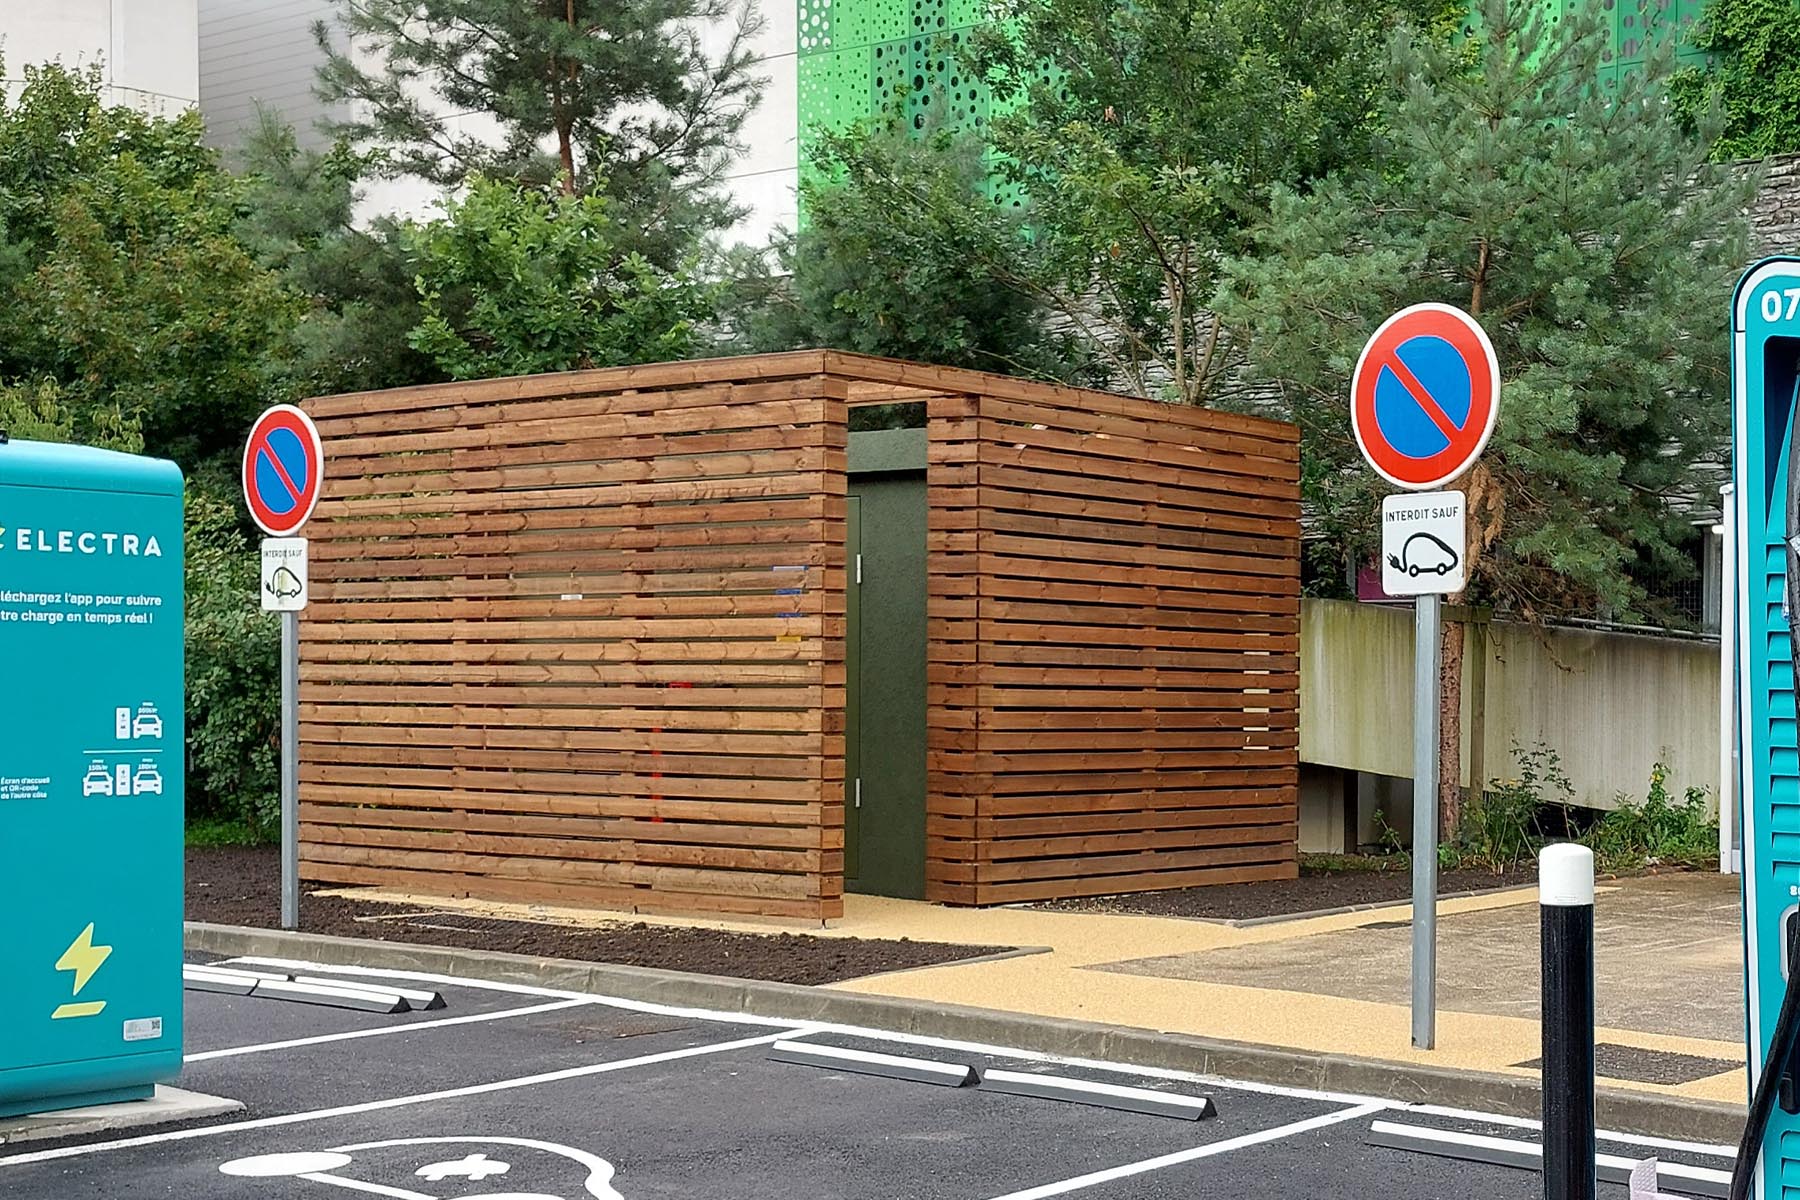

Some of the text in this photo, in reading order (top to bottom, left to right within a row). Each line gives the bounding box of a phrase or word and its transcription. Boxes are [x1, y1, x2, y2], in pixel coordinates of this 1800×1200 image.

[1761, 288, 1800, 322] 07
[1385, 506, 1459, 522] INTERDIT SAUF
[17, 528, 162, 557] ELECTRA
[264, 549, 303, 558] INTERDIT SAUF
[95, 595, 124, 607] pour
[126, 594, 162, 606] suivre
[21, 609, 64, 624] charge
[66, 612, 82, 622] en
[84, 612, 122, 625] temps
[124, 612, 147, 624] réel
